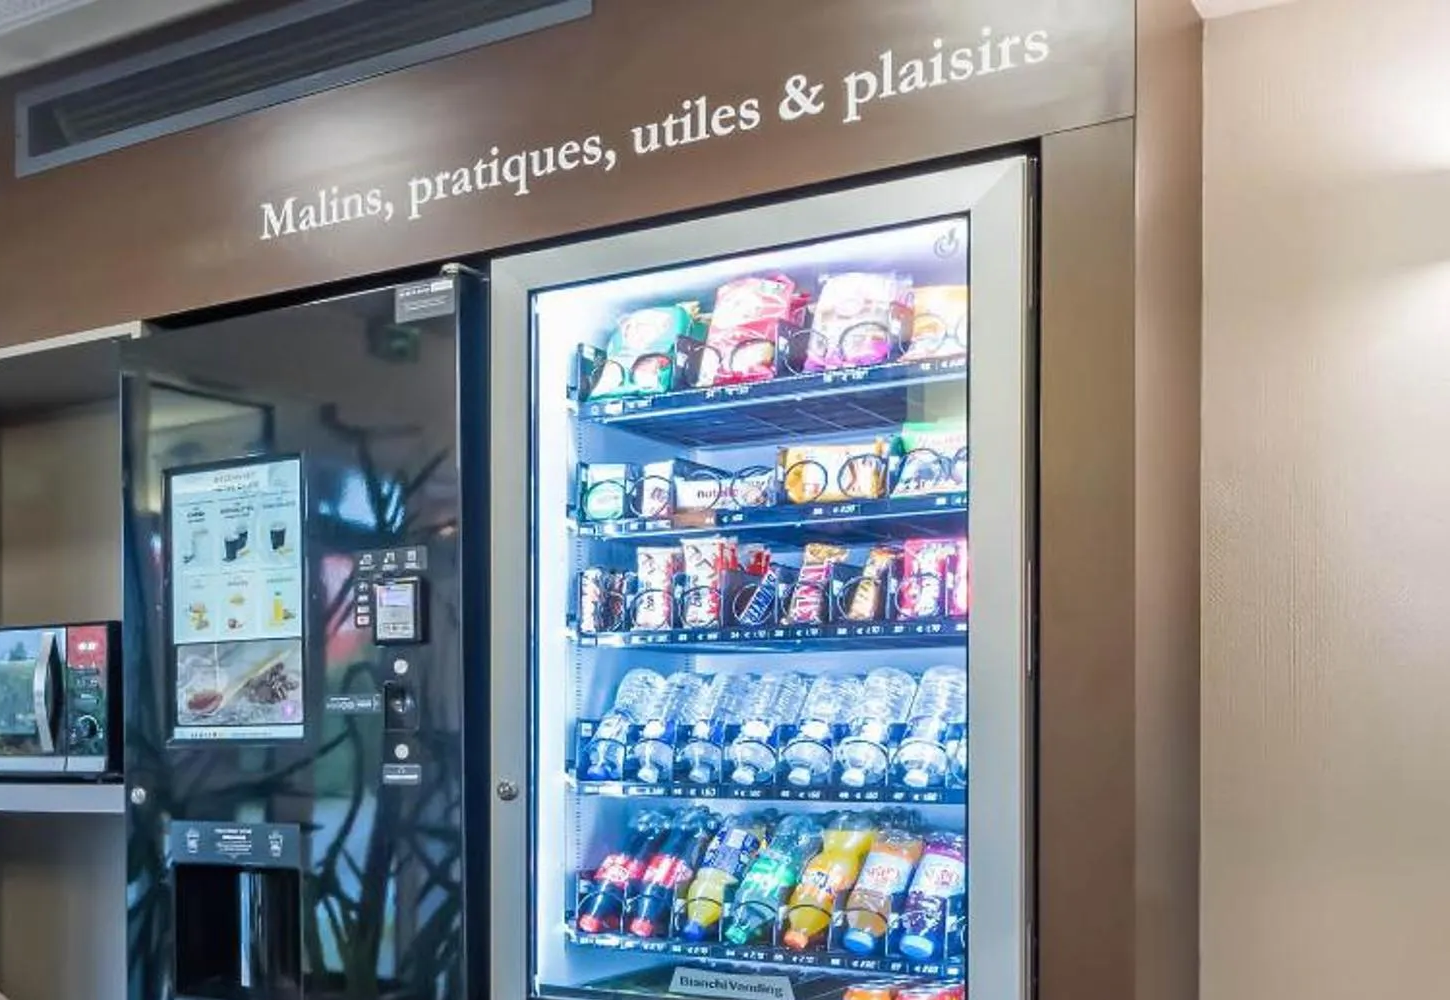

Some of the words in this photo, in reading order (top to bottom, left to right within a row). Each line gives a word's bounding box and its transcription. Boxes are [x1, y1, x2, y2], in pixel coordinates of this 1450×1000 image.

[259, 185, 394, 241] Malins,
[408, 135, 617, 220] pratiques,
[630, 96, 761, 155] utiles
[778, 73, 825, 121] &
[842, 27, 1048, 124] plaisirs
